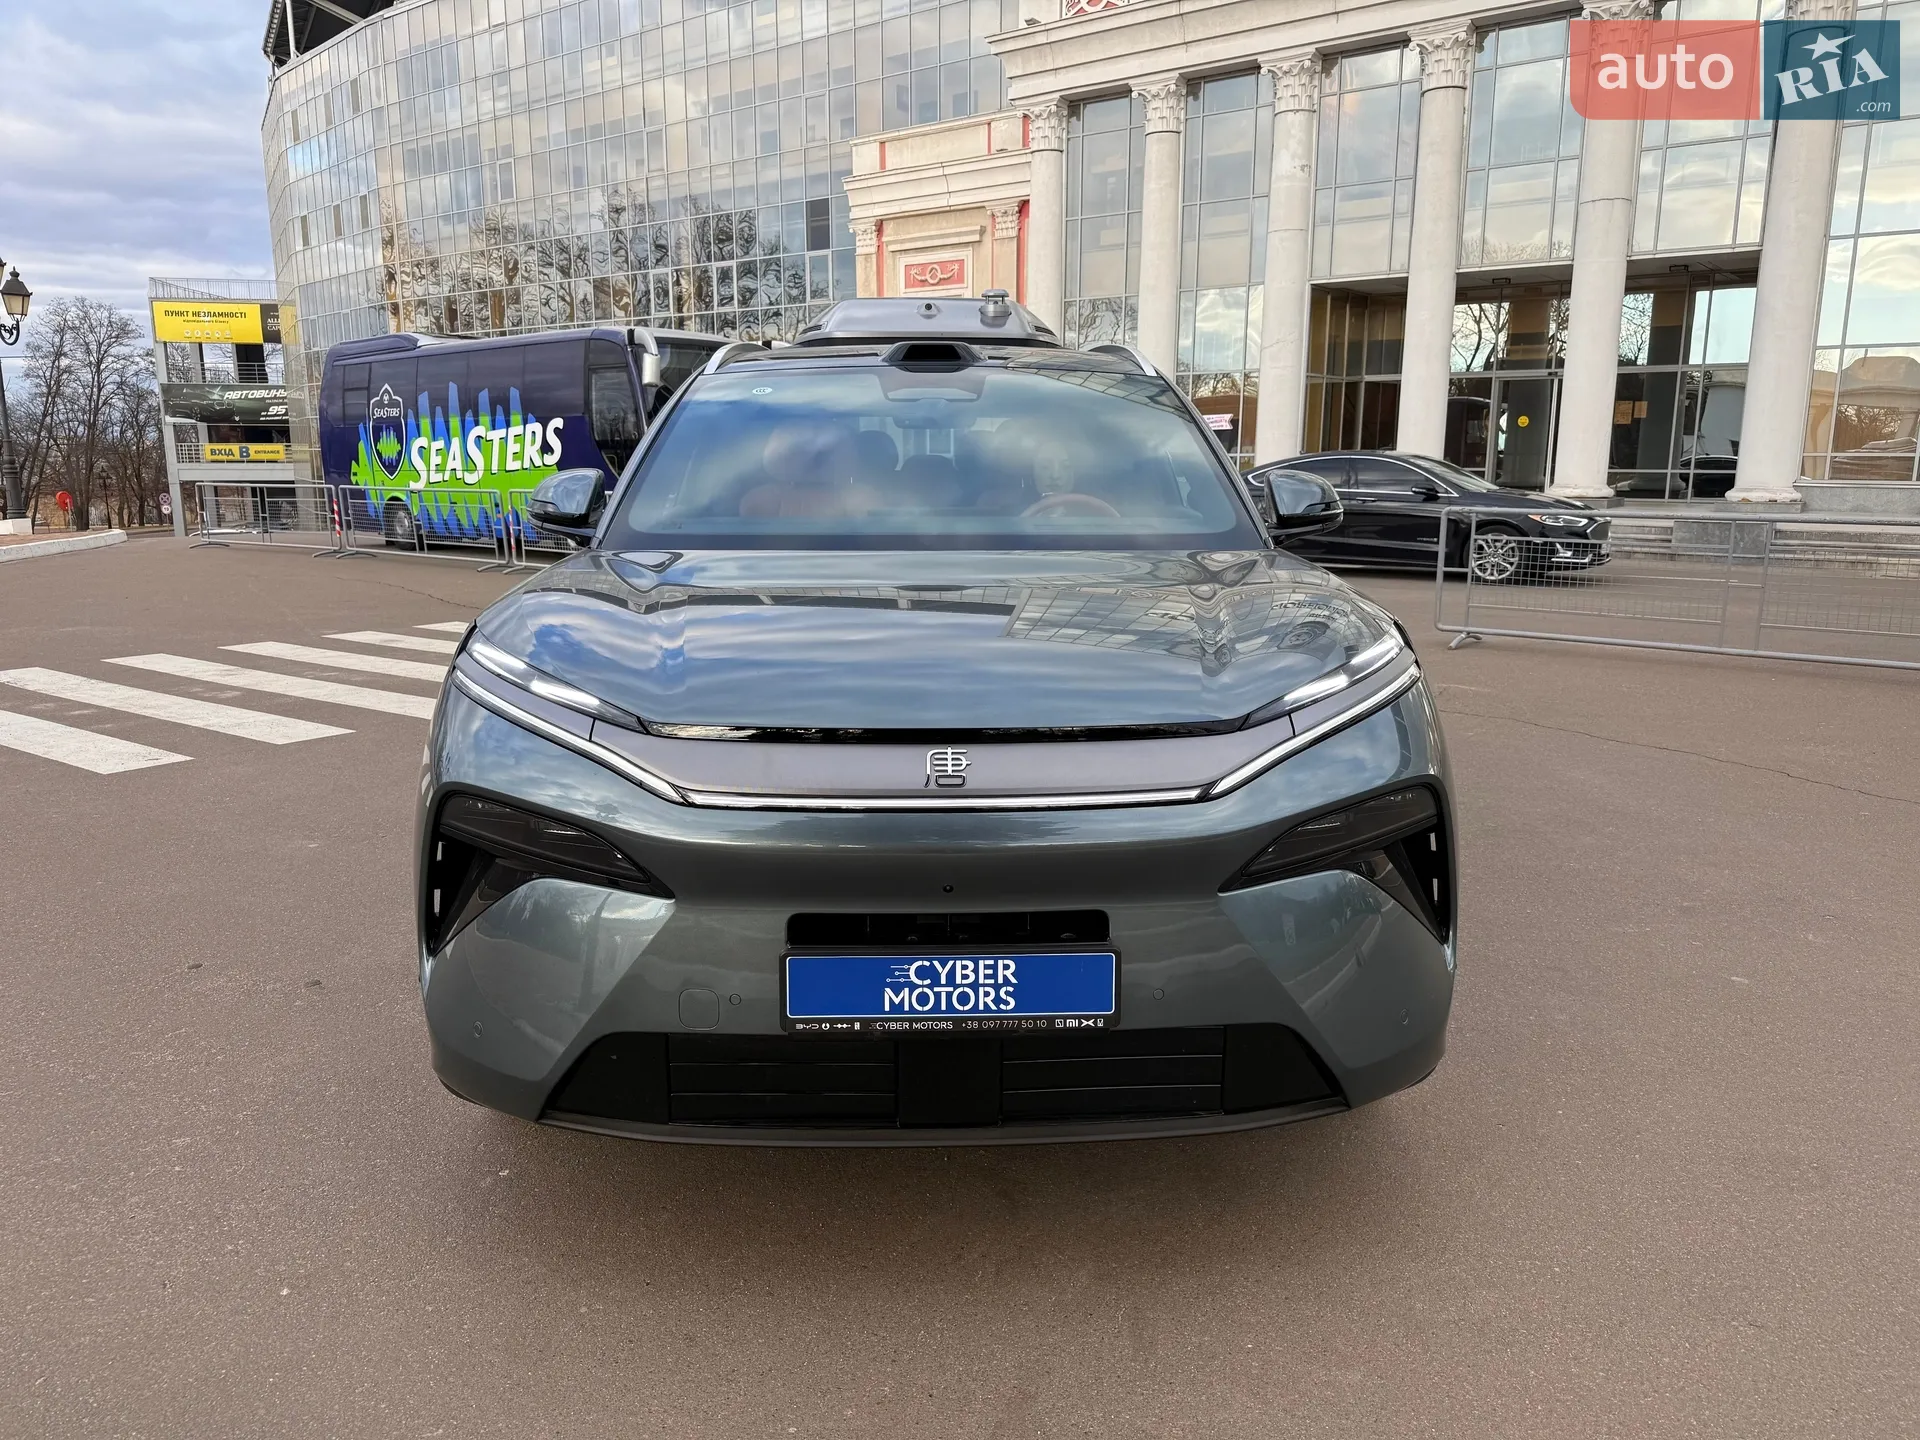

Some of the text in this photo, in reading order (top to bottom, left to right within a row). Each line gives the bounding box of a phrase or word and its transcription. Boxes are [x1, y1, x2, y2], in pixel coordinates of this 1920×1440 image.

[164, 309, 247, 319] ПУНКТ НЕЗЛАМНОСТІ
[210, 448, 236, 458] ВХІД
[908, 959, 1019, 986] CYBER
[883, 986, 1017, 1012] MOTORS
[876, 1021, 910, 1030] CYBER
[912, 1021, 953, 1030] MOTORS
[962, 1020, 979, 1029] +38
[981, 1020, 1000, 1029] 097
[1002, 1020, 1018, 1028] 777
[1021, 1020, 1034, 1028] 50
[1036, 1019, 1047, 1028] 10
